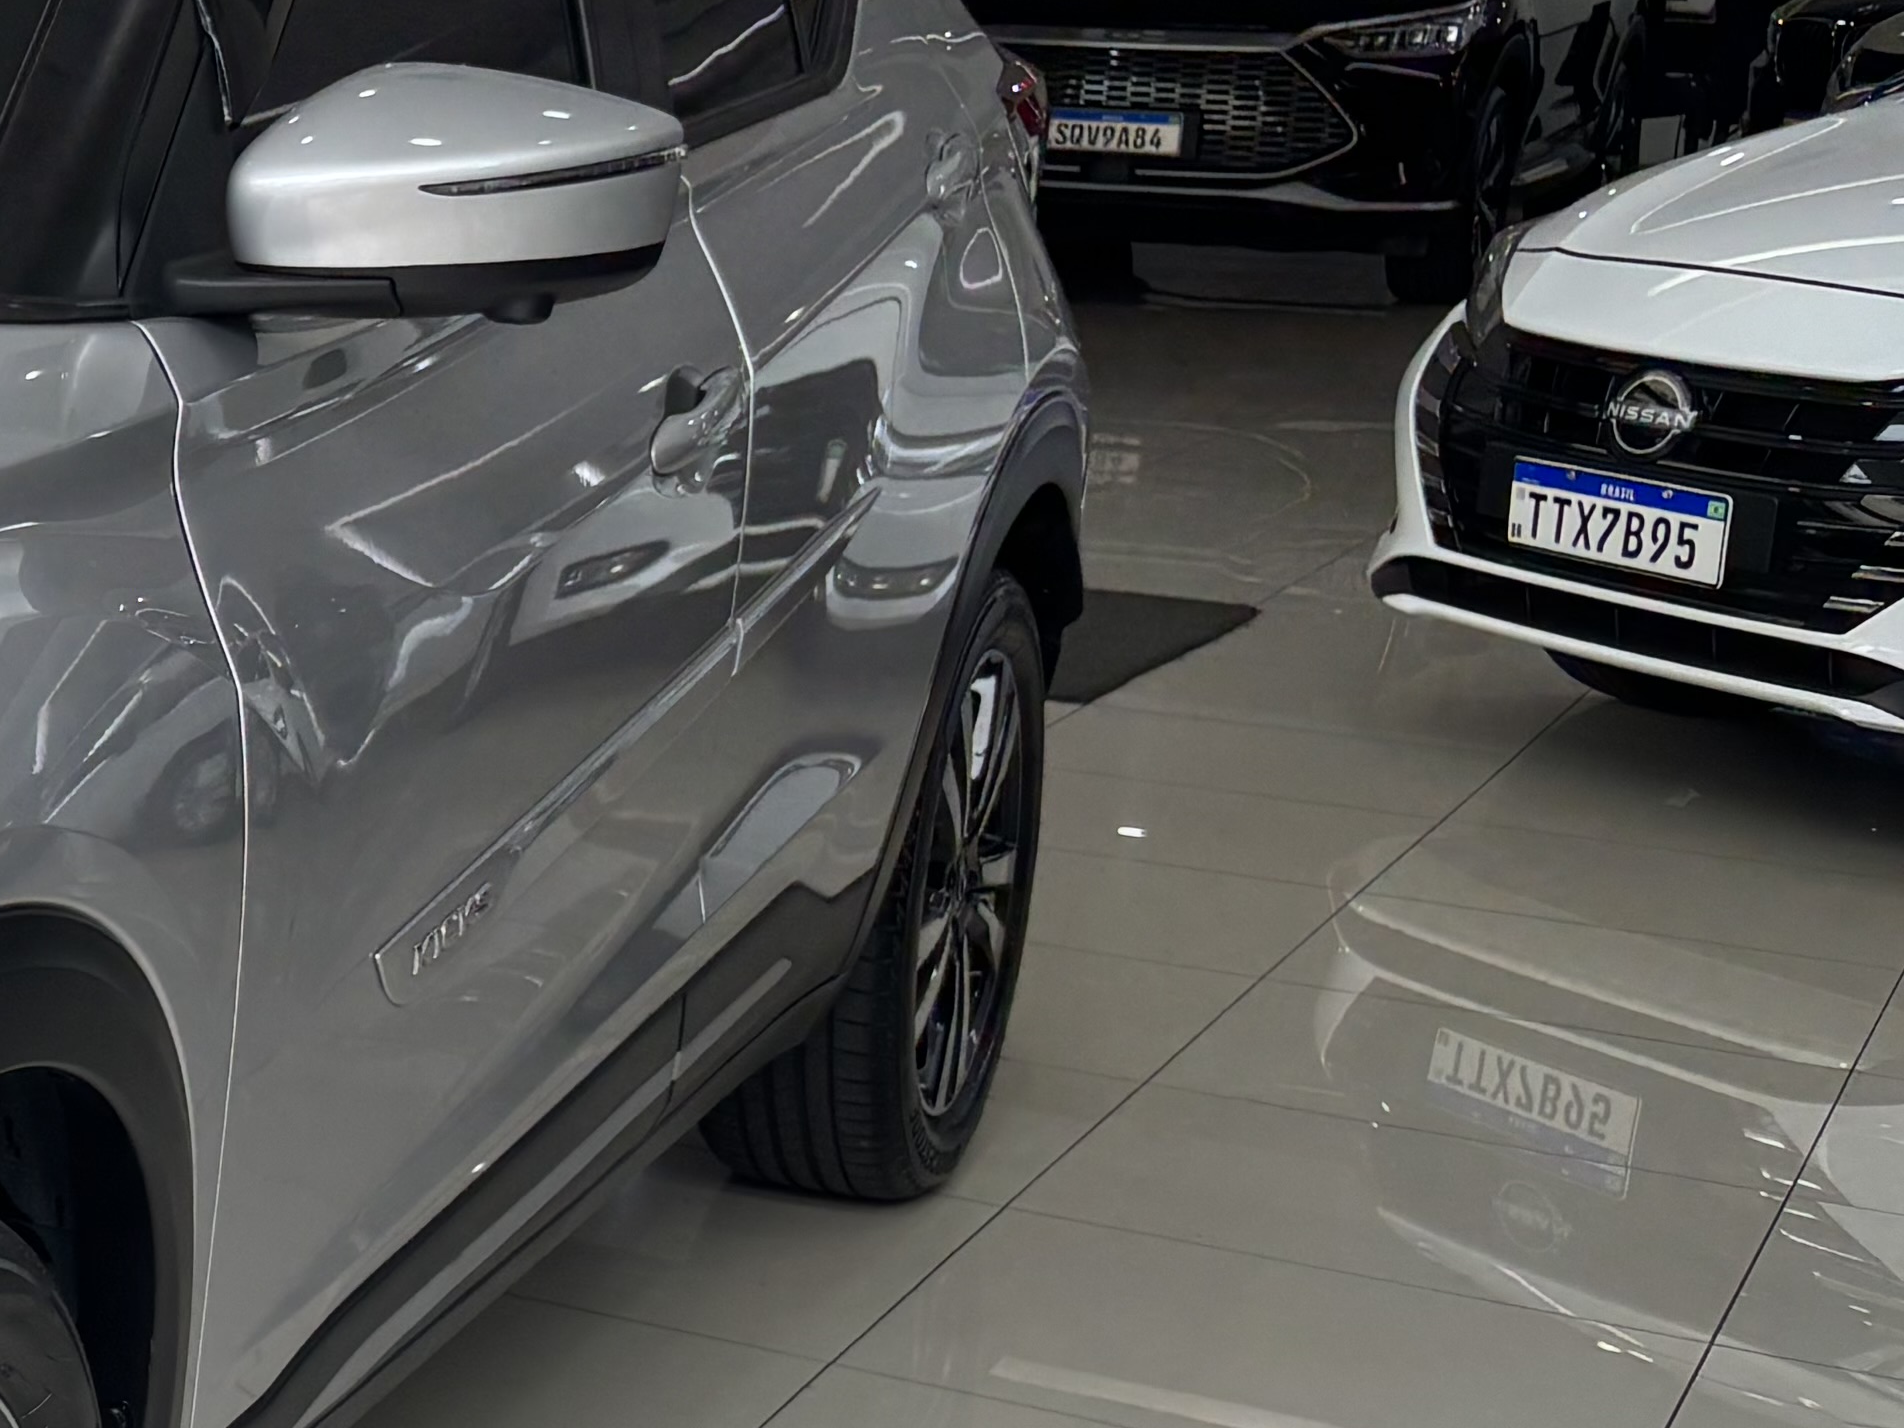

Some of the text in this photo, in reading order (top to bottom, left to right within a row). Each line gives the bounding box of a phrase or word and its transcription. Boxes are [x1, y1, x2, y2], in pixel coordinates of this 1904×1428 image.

[1054, 123, 1162, 150] SQV9A84
[1607, 402, 1698, 429] NISSAN
[1600, 483, 1635, 502] BRASIL
[1529, 491, 1700, 570] TTX7B95
